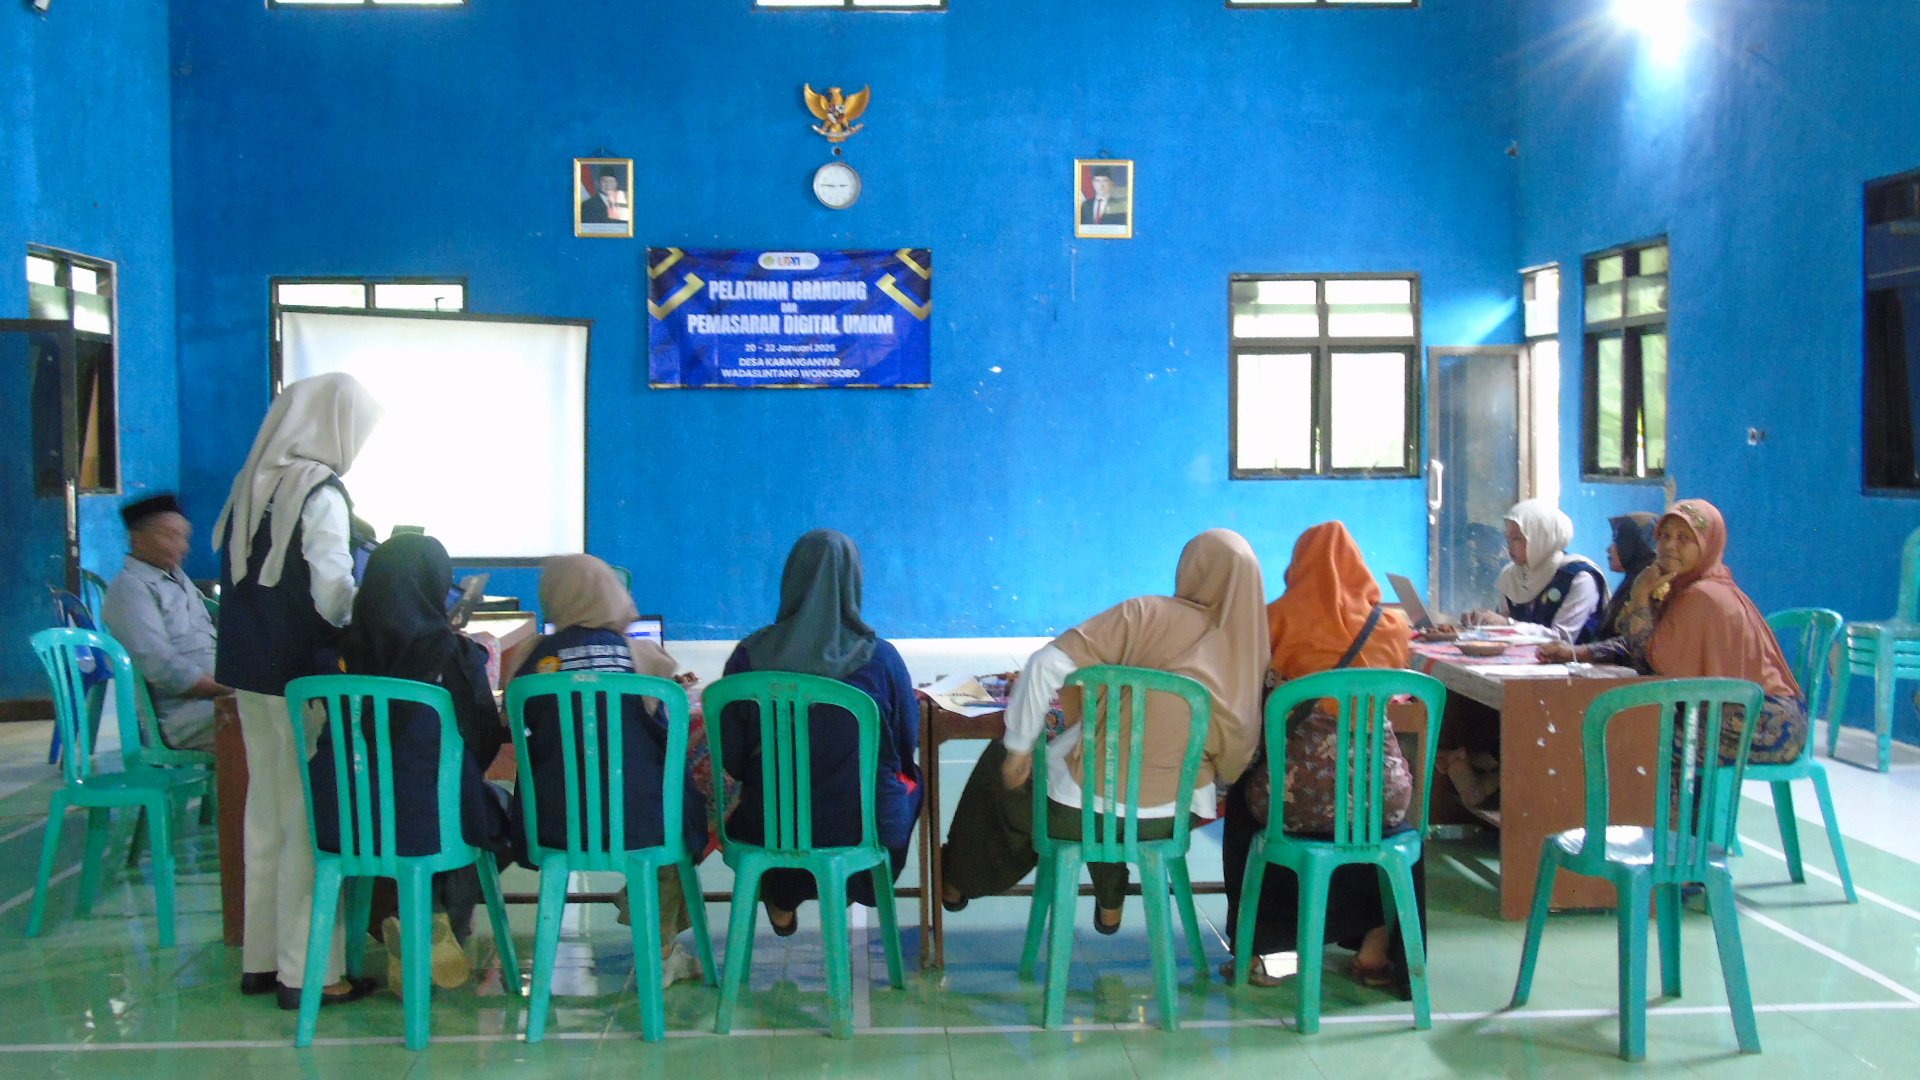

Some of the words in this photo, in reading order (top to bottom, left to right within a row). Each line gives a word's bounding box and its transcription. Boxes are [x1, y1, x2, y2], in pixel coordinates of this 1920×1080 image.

[709, 280, 789, 300] PELATIHAN
[792, 280, 867, 300] BRANDING
[687, 314, 780, 334] PEMASARAN
[783, 314, 840, 334] DIGITAL
[842, 314, 894, 334] UMKM
[776, 343, 813, 352] Januari
[738, 357, 764, 366] DESA
[765, 357, 841, 367] KARANGANYAR
[721, 369, 800, 378] WADASLINTANG
[800, 369, 861, 378] WONOSOBO
